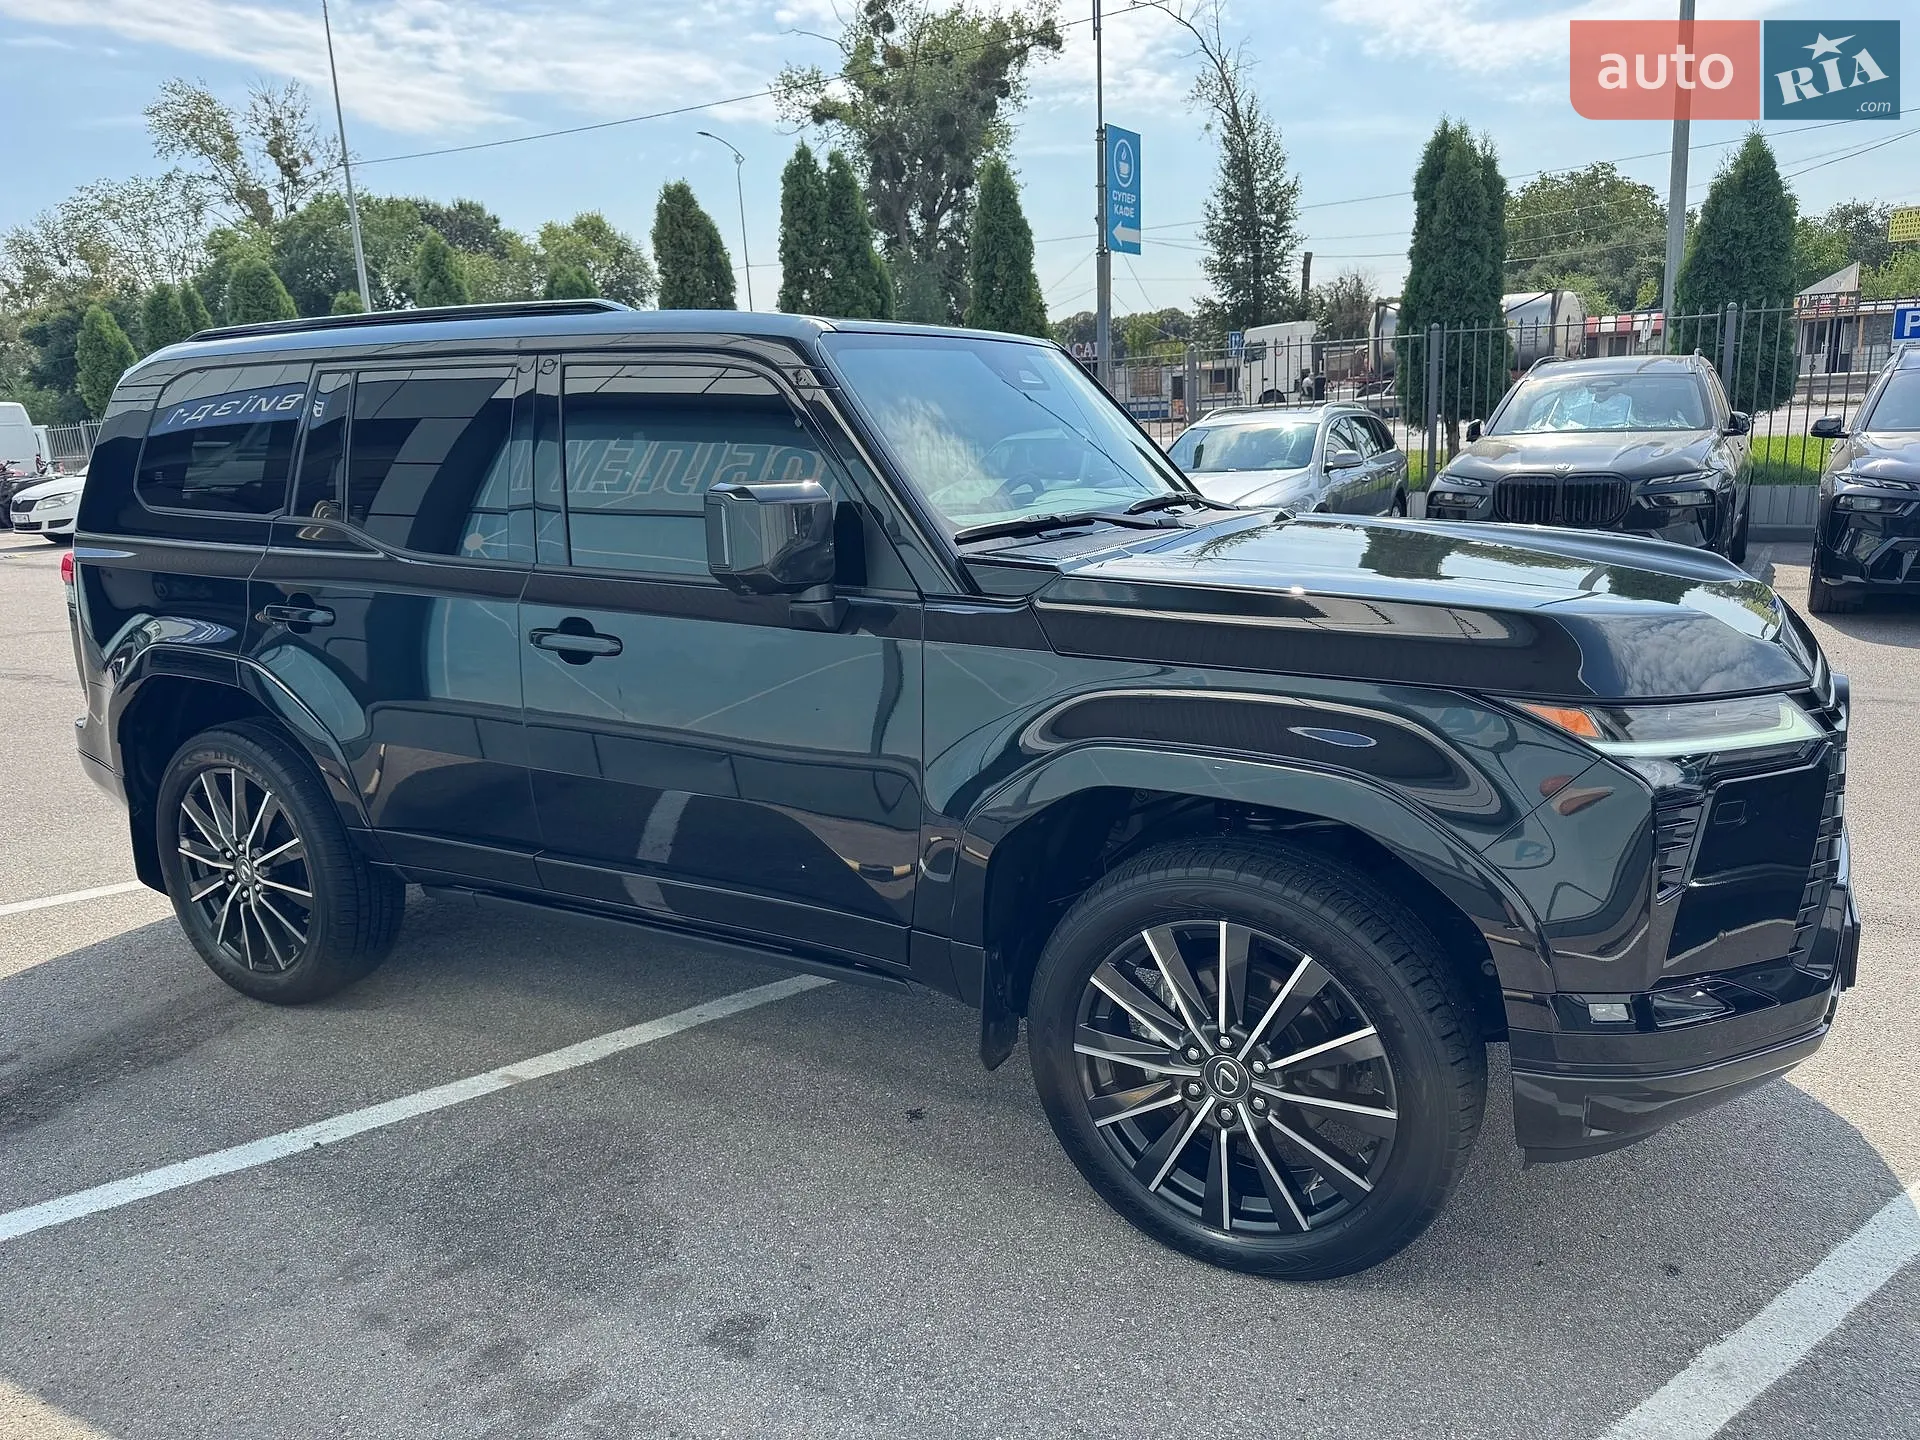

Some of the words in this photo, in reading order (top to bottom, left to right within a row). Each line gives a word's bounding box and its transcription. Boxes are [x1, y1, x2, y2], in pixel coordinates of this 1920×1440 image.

[1112, 189, 1136, 205] СУПЕР
[1113, 203, 1135, 218] КАФЕ
[1903, 310, 1920, 337] P
